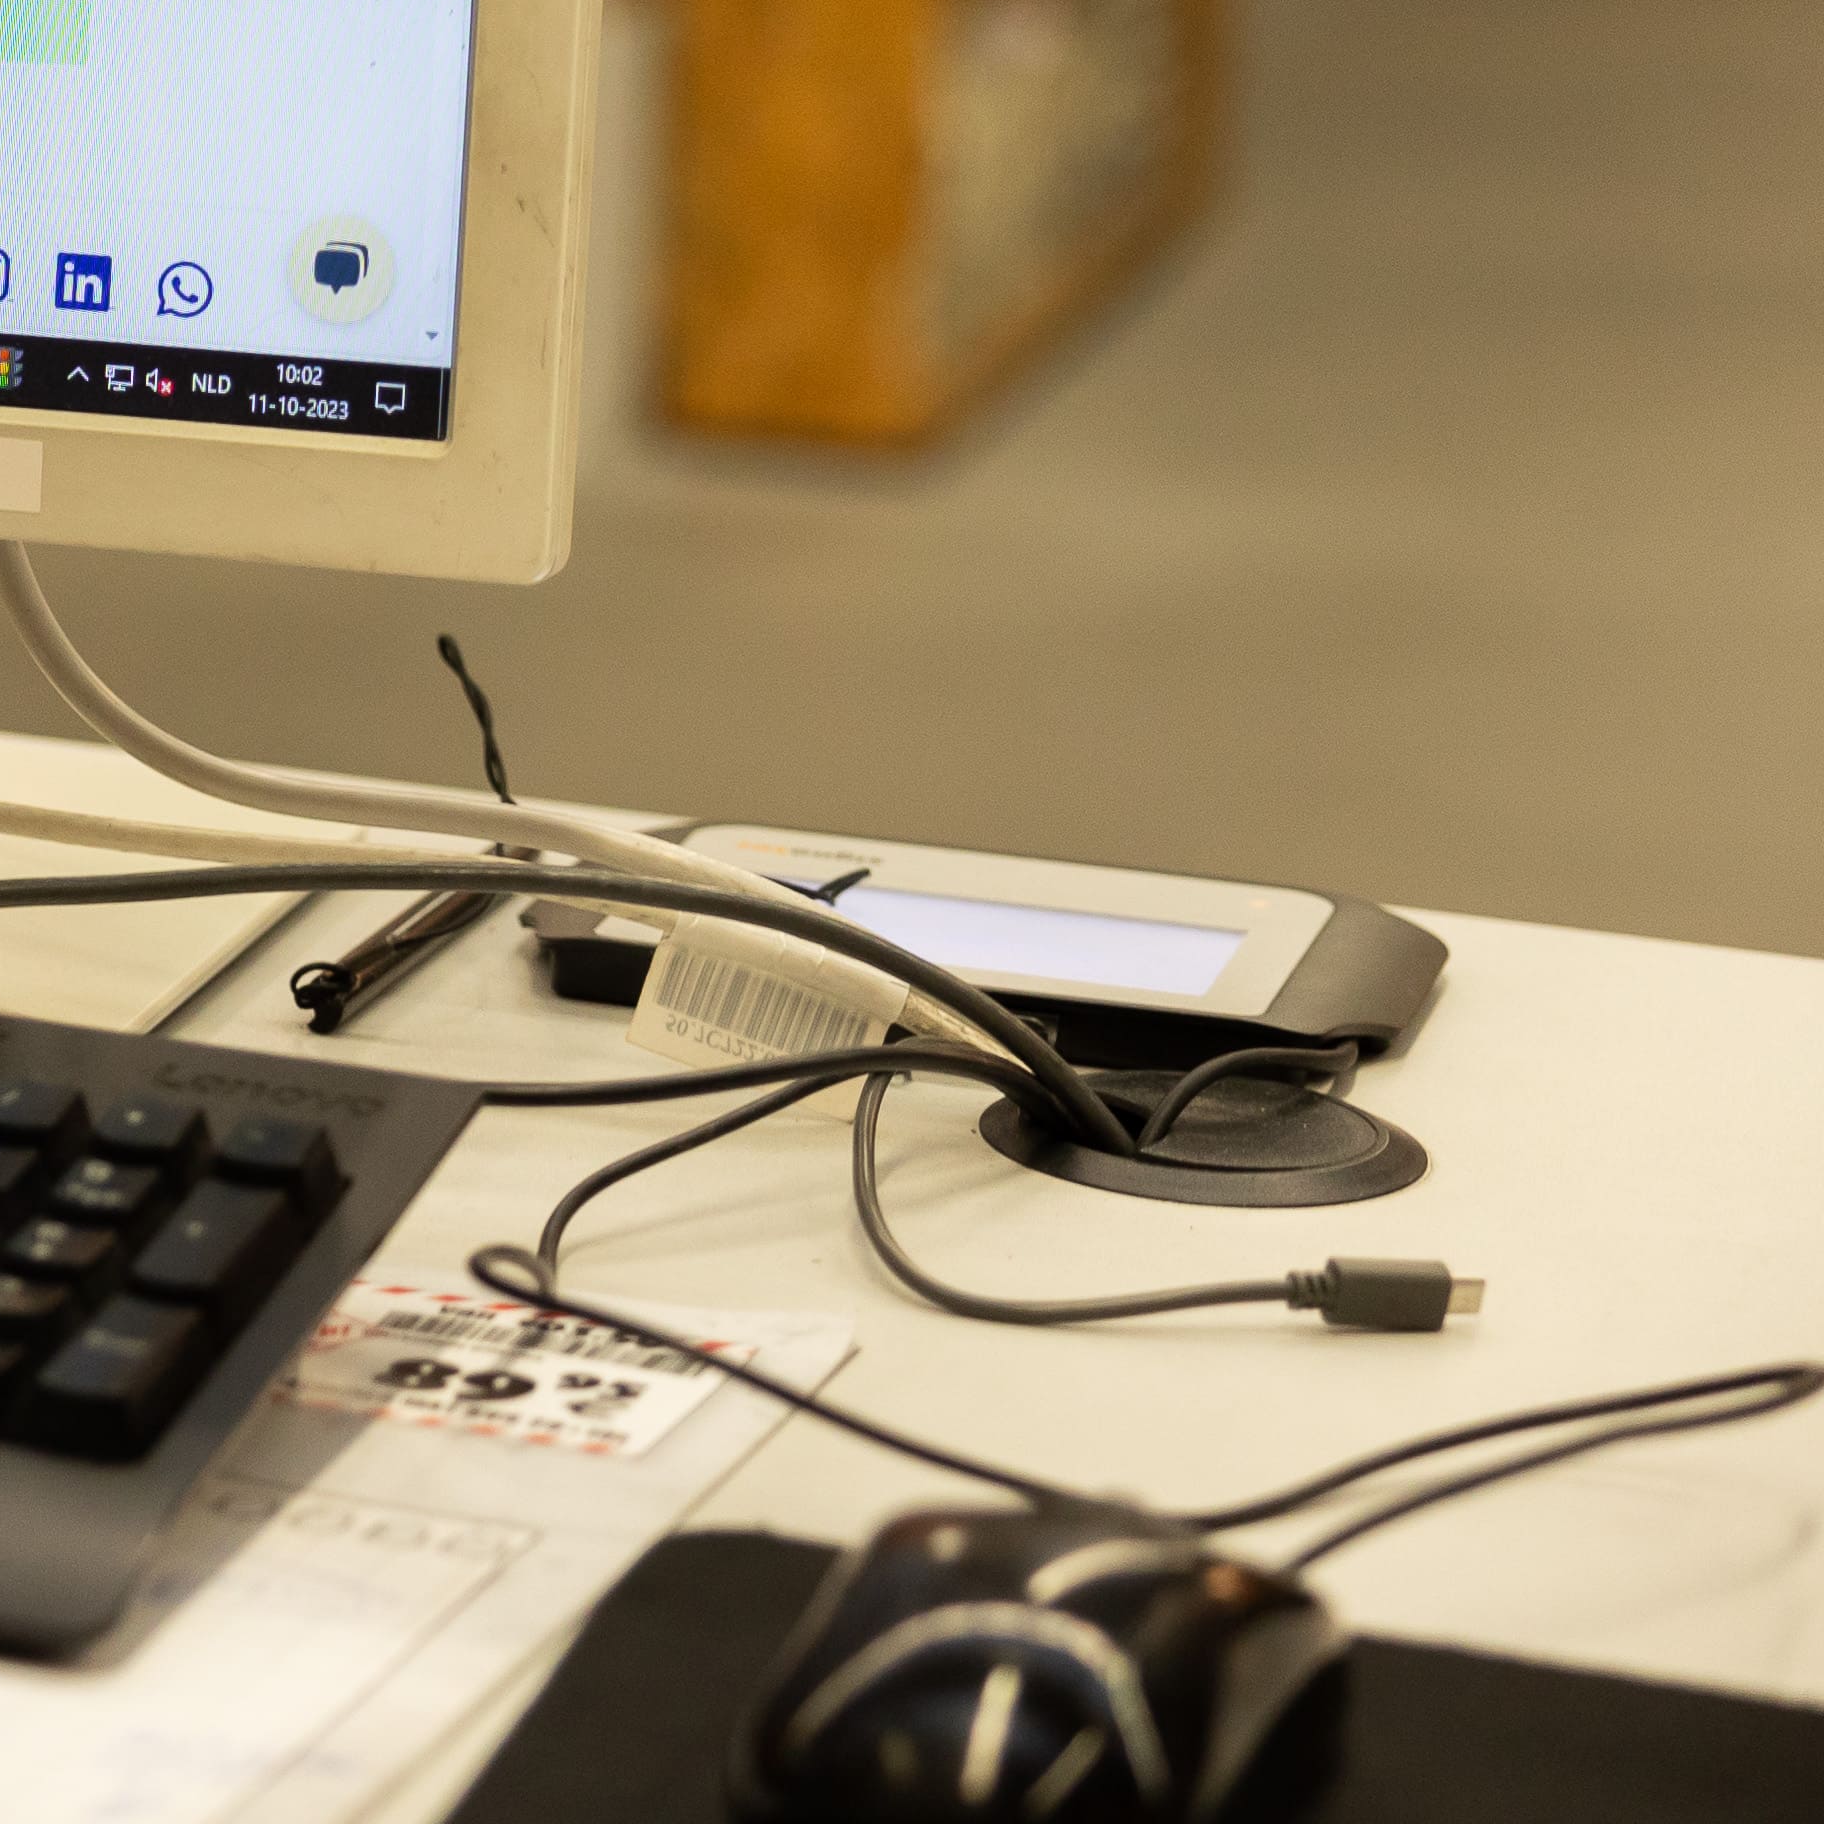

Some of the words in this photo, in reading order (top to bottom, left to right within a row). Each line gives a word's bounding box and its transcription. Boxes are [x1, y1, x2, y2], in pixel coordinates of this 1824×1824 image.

[191, 372, 232, 395] NLD
[276, 363, 323, 387] 10:02
[248, 393, 350, 421] 11-10-2023
